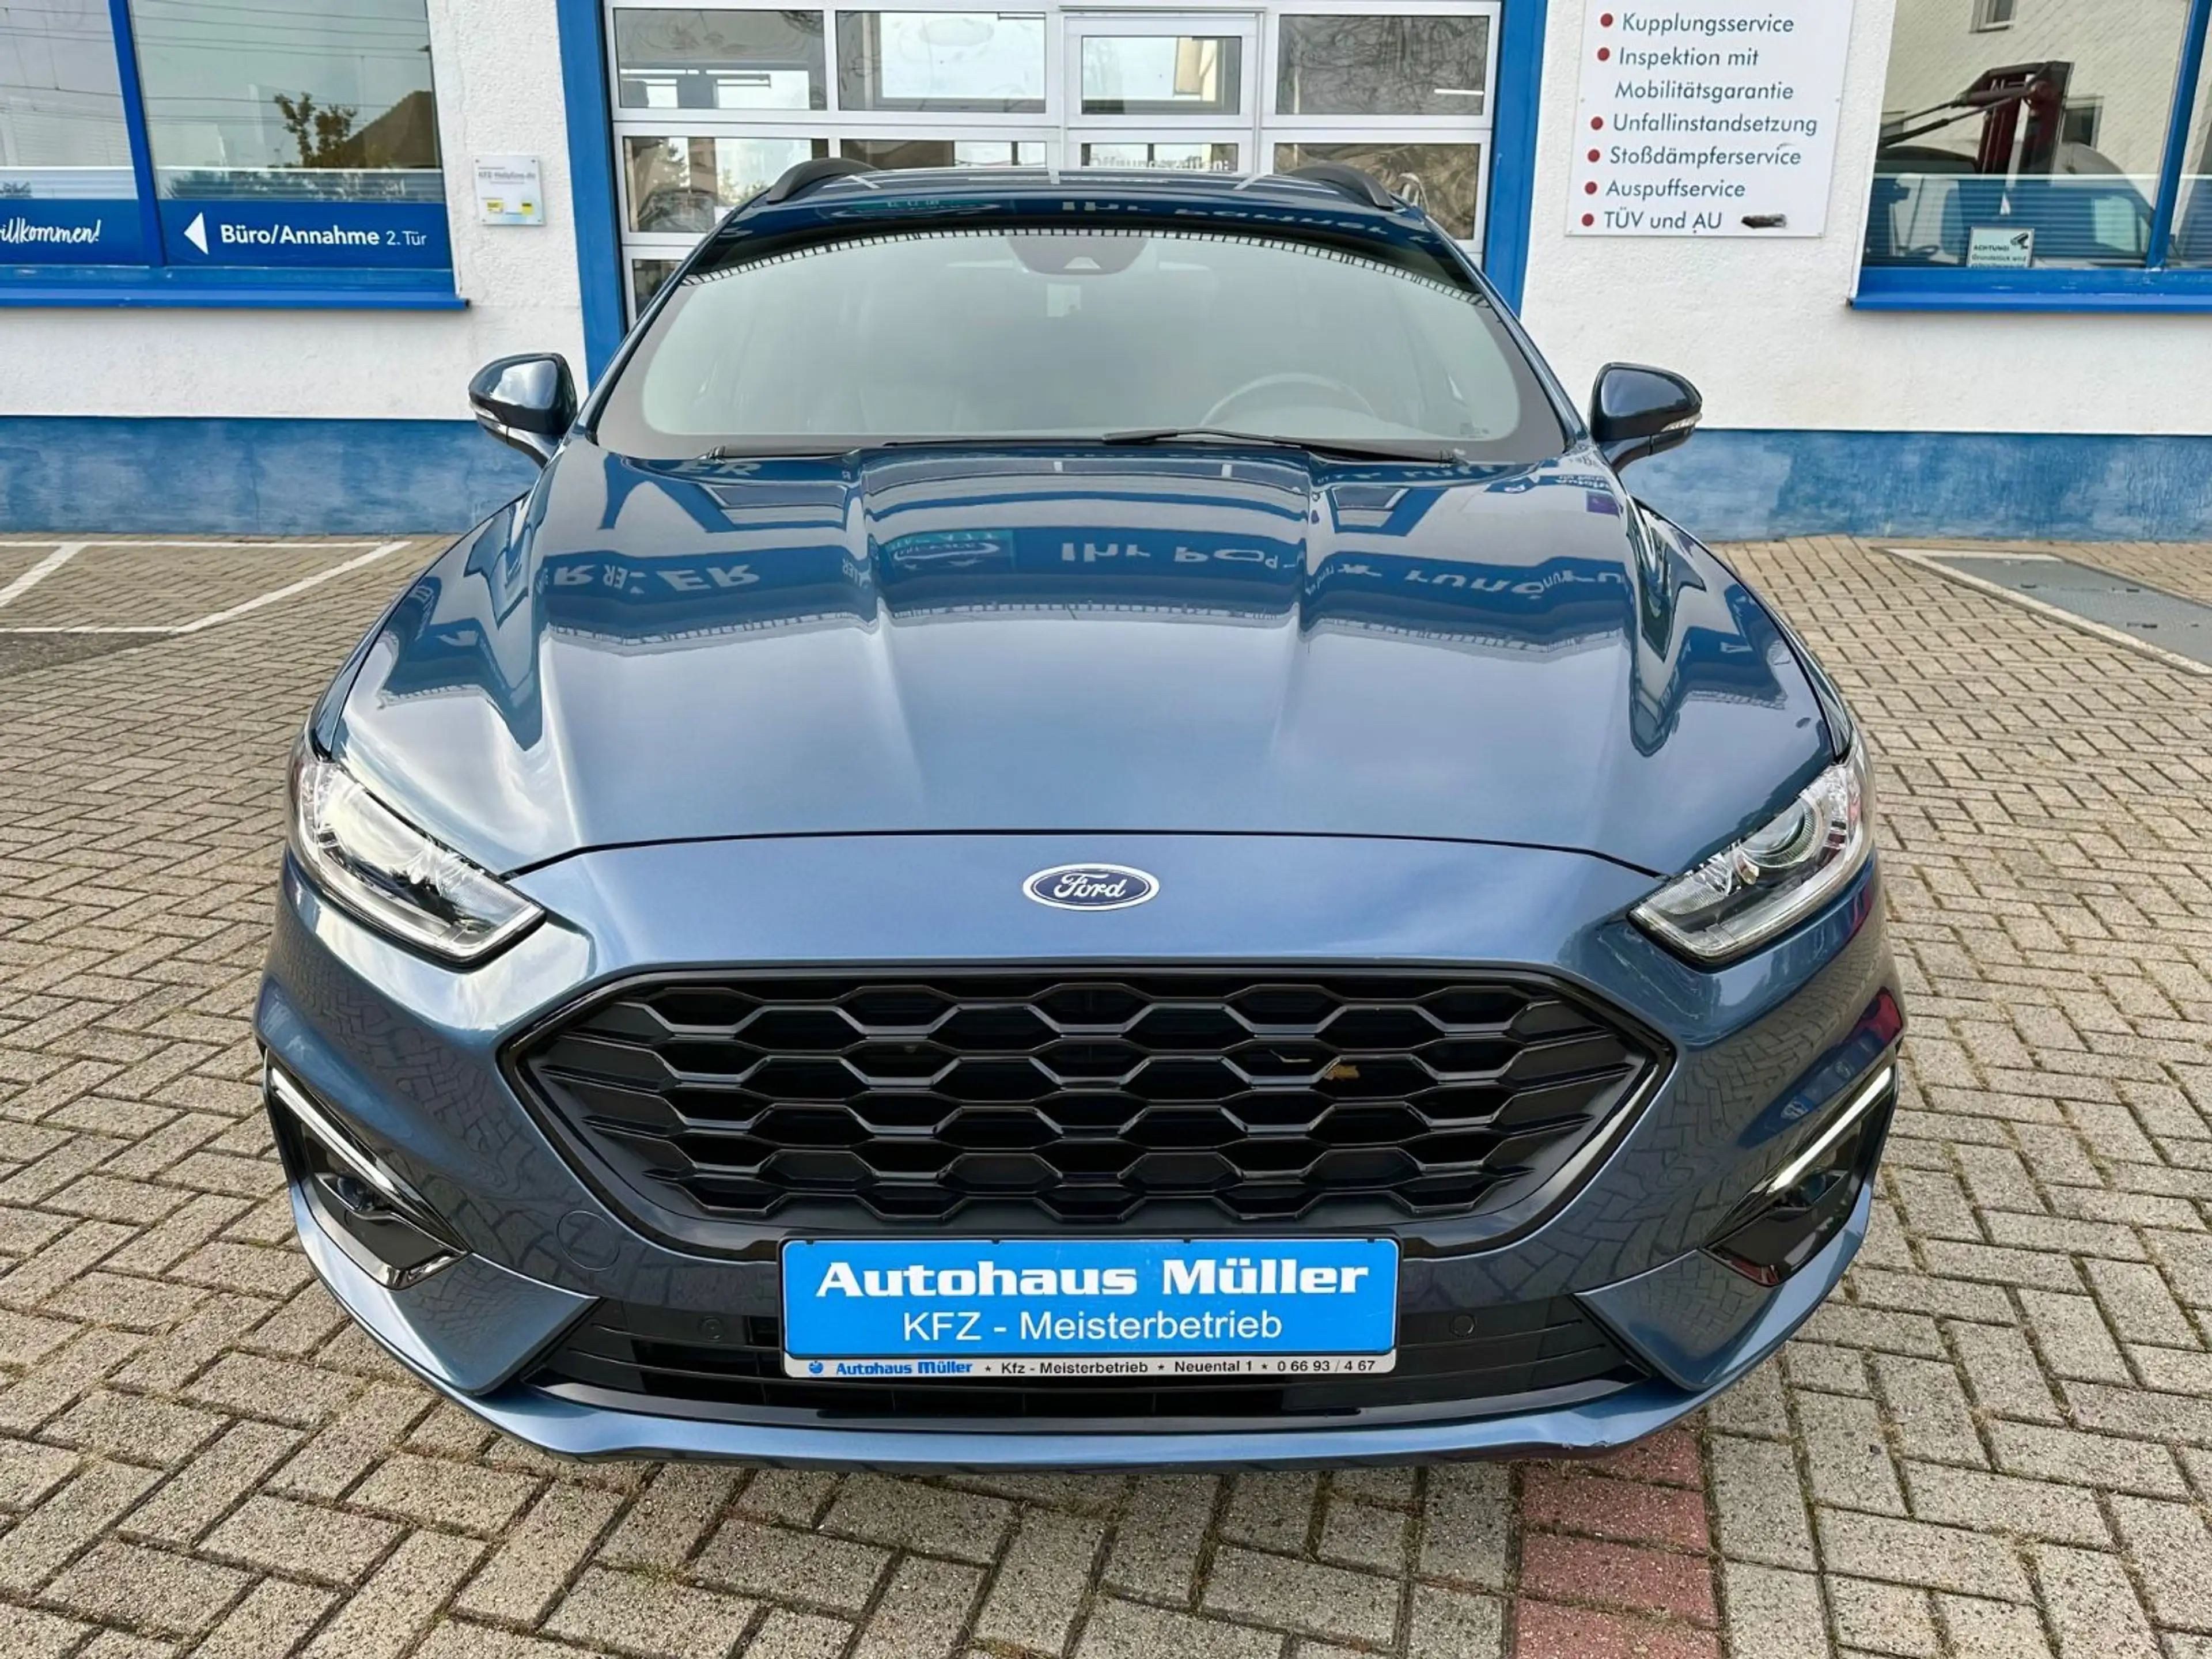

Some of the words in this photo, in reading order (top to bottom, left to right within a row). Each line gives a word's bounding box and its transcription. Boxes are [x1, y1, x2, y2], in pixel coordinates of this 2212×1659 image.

[1622, 12, 1794, 36] Kupplungsservice
[1619, 47, 1720, 70] Inspektion
[1727, 47, 1759, 66] mit
[1615, 80, 1794, 103] Mobilitätsgarantie
[1613, 112, 1818, 136] Unfallinstandsetzung
[1609, 146, 1802, 169] Stoßdämpferservice
[1605, 178, 1746, 200] Auspuffservice
[1604, 207, 1644, 229] TÜV
[1650, 211, 1687, 229] und
[1692, 212, 1723, 229] AU
[0, 217, 102, 244] illkommen!
[220, 224, 380, 245] Büro/Annahme
[385, 230, 402, 246] 2.
[402, 230, 427, 247] Tür
[1053, 872, 1128, 899] Ford
[815, 1261, 1138, 1297] Autohaus
[1162, 1257, 1369, 1295] Müller
[903, 1311, 982, 1342] KFZ
[1020, 1309, 1283, 1340] Meisterbetrieb
[836, 1362, 912, 1375] Autohaus
[917, 1360, 972, 1374] Müller
[1001, 1362, 1025, 1374] Kfz
[1039, 1361, 1149, 1374] Meisterbetrieb
[1174, 1360, 1240, 1372] Neuental
[1245, 1360, 1252, 1372] 1
[1277, 1361, 1286, 1372] 0
[1290, 1360, 1308, 1372] 66
[1313, 1360, 1330, 1372] 93
[1344, 1360, 1353, 1371] 4
[1358, 1360, 1376, 1371] 67
